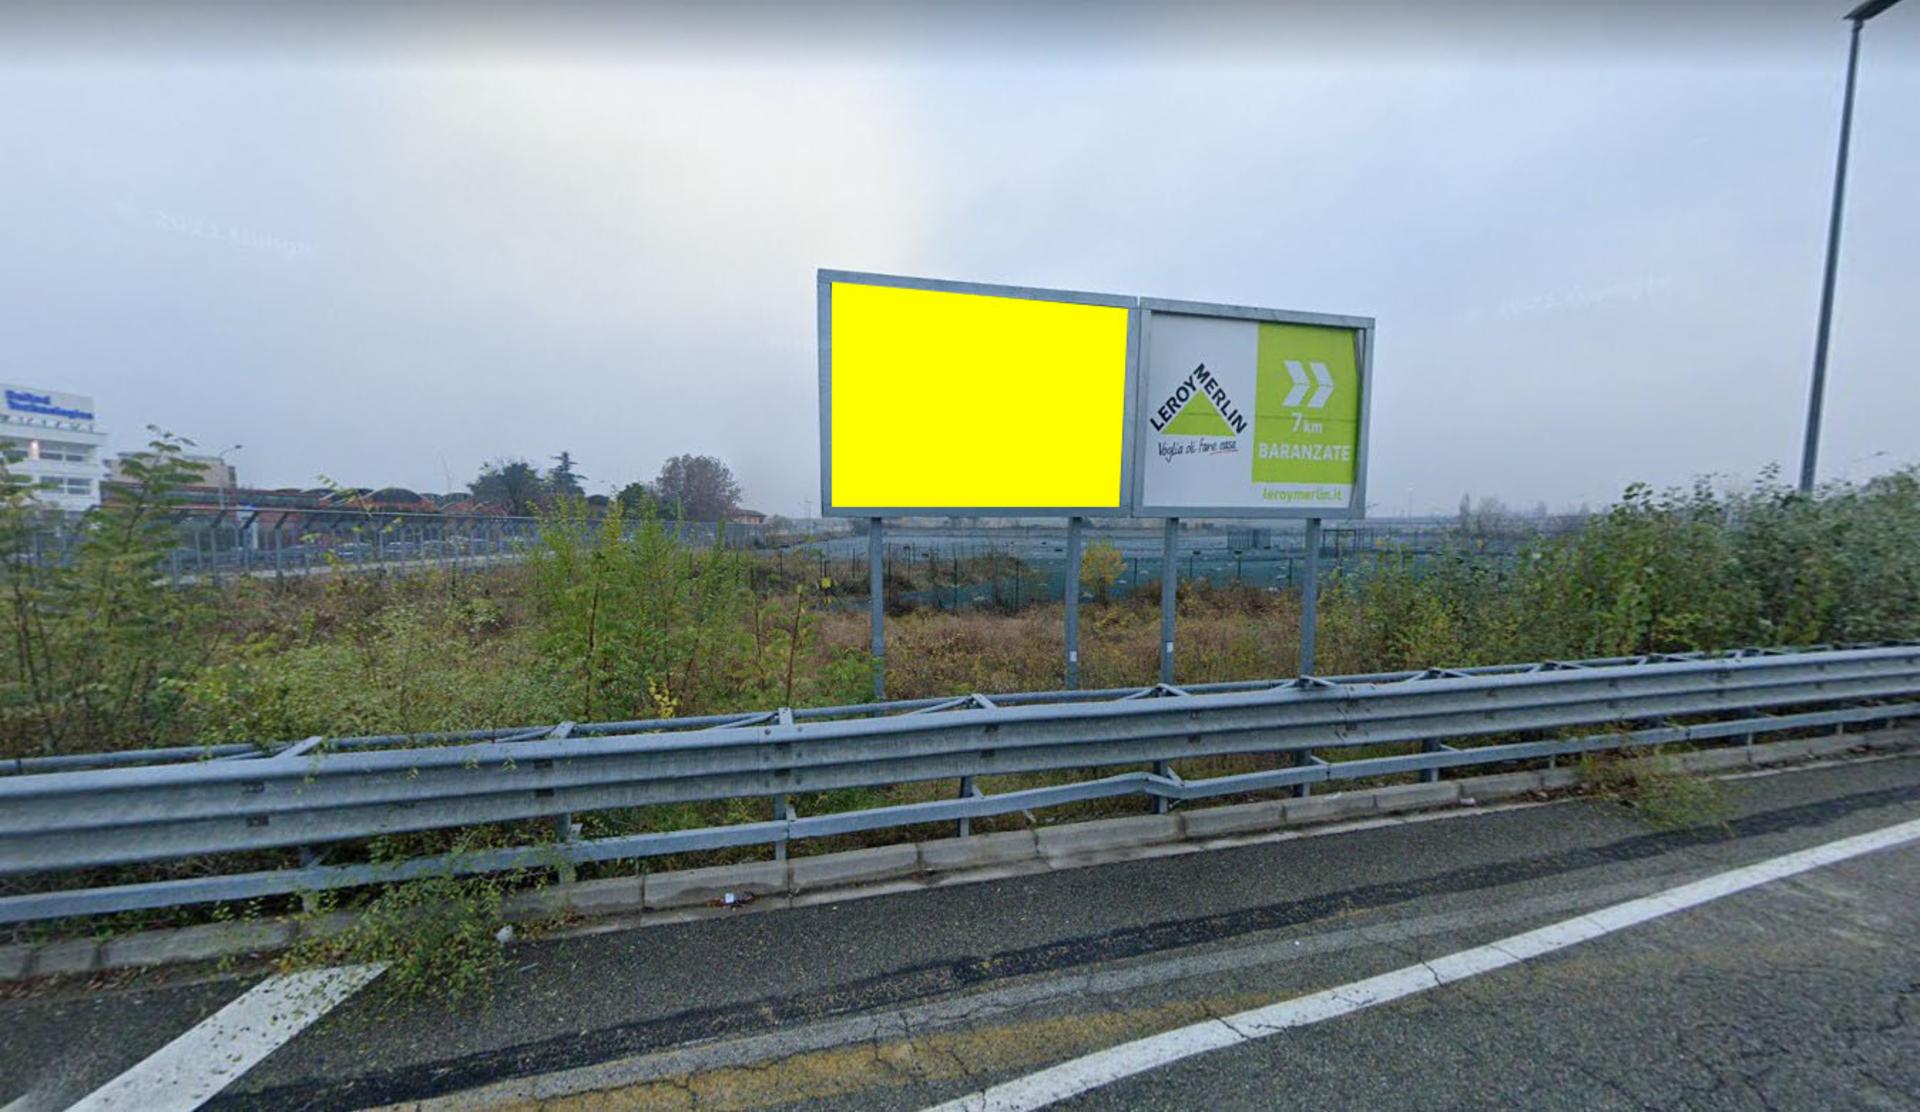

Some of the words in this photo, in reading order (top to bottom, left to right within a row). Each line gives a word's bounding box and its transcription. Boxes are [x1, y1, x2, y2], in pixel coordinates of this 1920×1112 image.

[1149, 375, 1197, 432] LEROY
[1193, 363, 1248, 434] MERLIN
[1291, 412, 1303, 433] 7
[1303, 420, 1323, 434] km
[1158, 441, 1184, 463] Voglia
[1185, 440, 1196, 454] di
[1199, 437, 1217, 452] fare
[1259, 442, 1351, 462] BARANZATE
